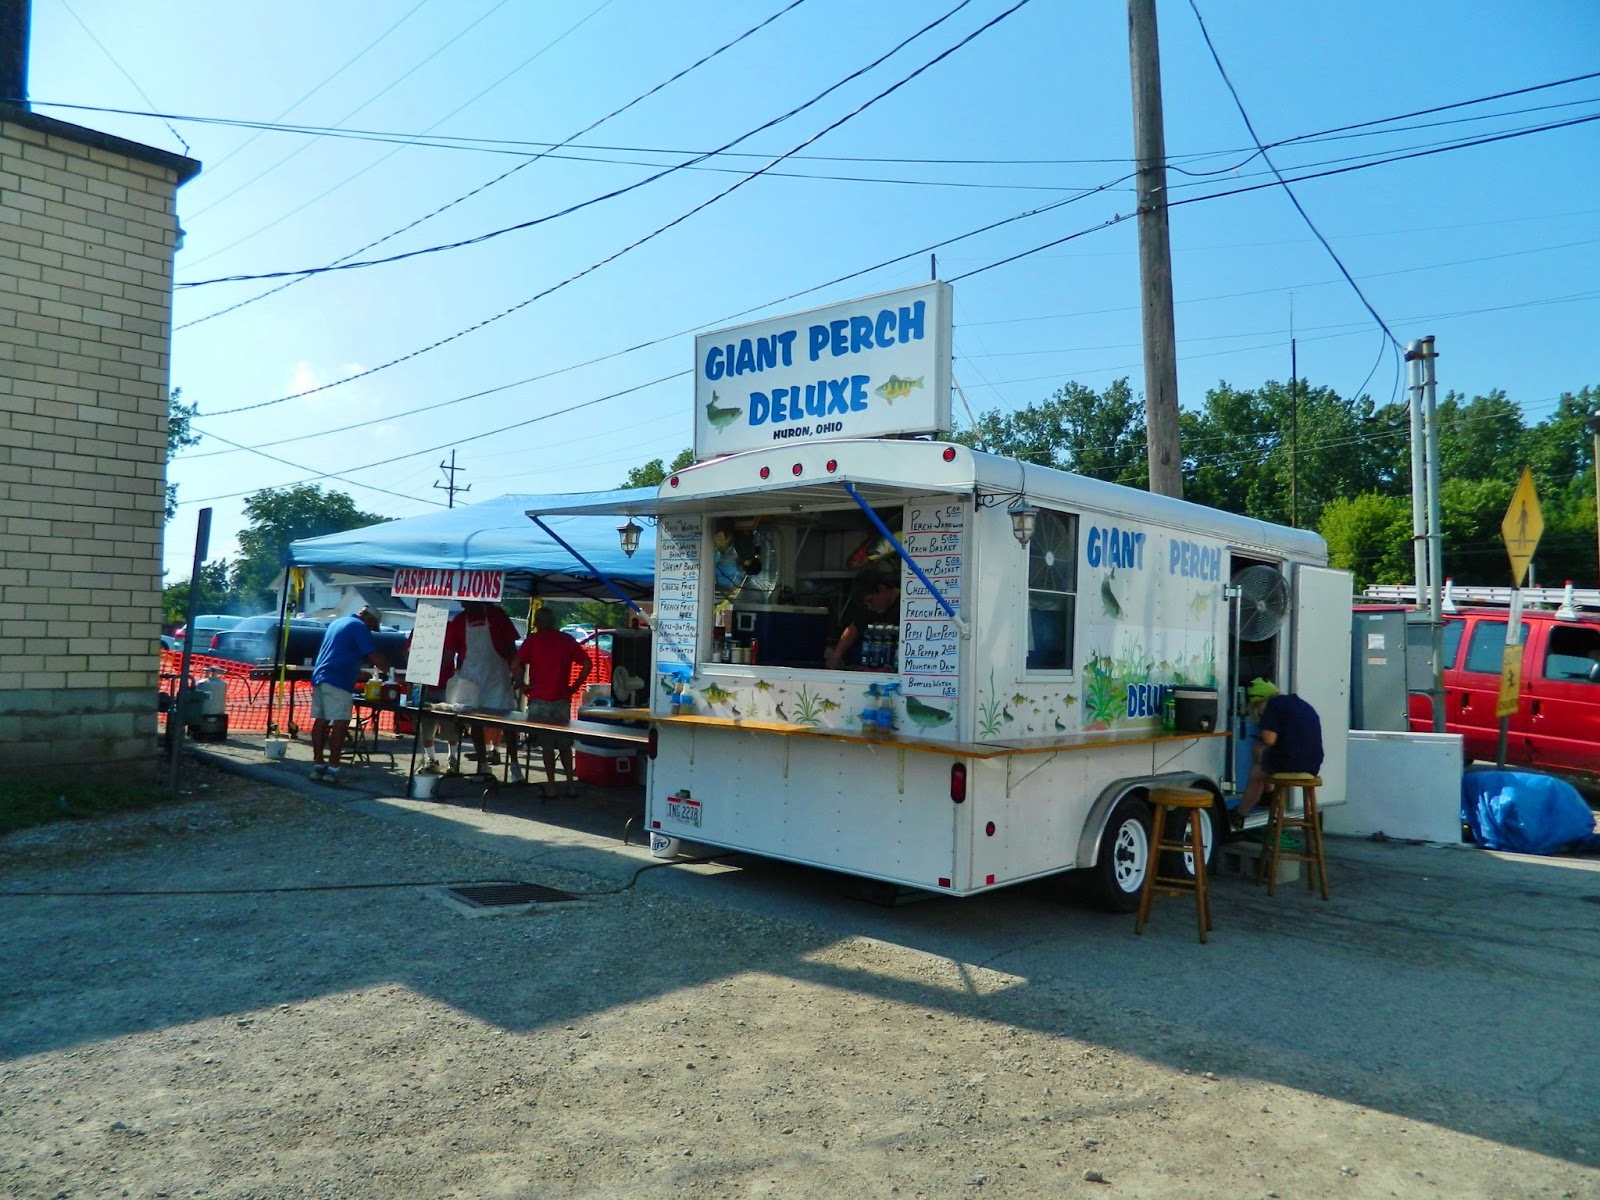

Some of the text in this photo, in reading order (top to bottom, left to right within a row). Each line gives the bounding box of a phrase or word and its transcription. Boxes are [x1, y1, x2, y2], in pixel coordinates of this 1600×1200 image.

[705, 300, 926, 381] GIANT PERCH
[748, 375, 870, 426] DELUXE
[773, 421, 843, 440] HURON, OHIO
[1087, 526, 1222, 582] GIANT PERCH
[394, 569, 502, 599] CASTALIA LIONS
[1127, 682, 1175, 718] DELU
